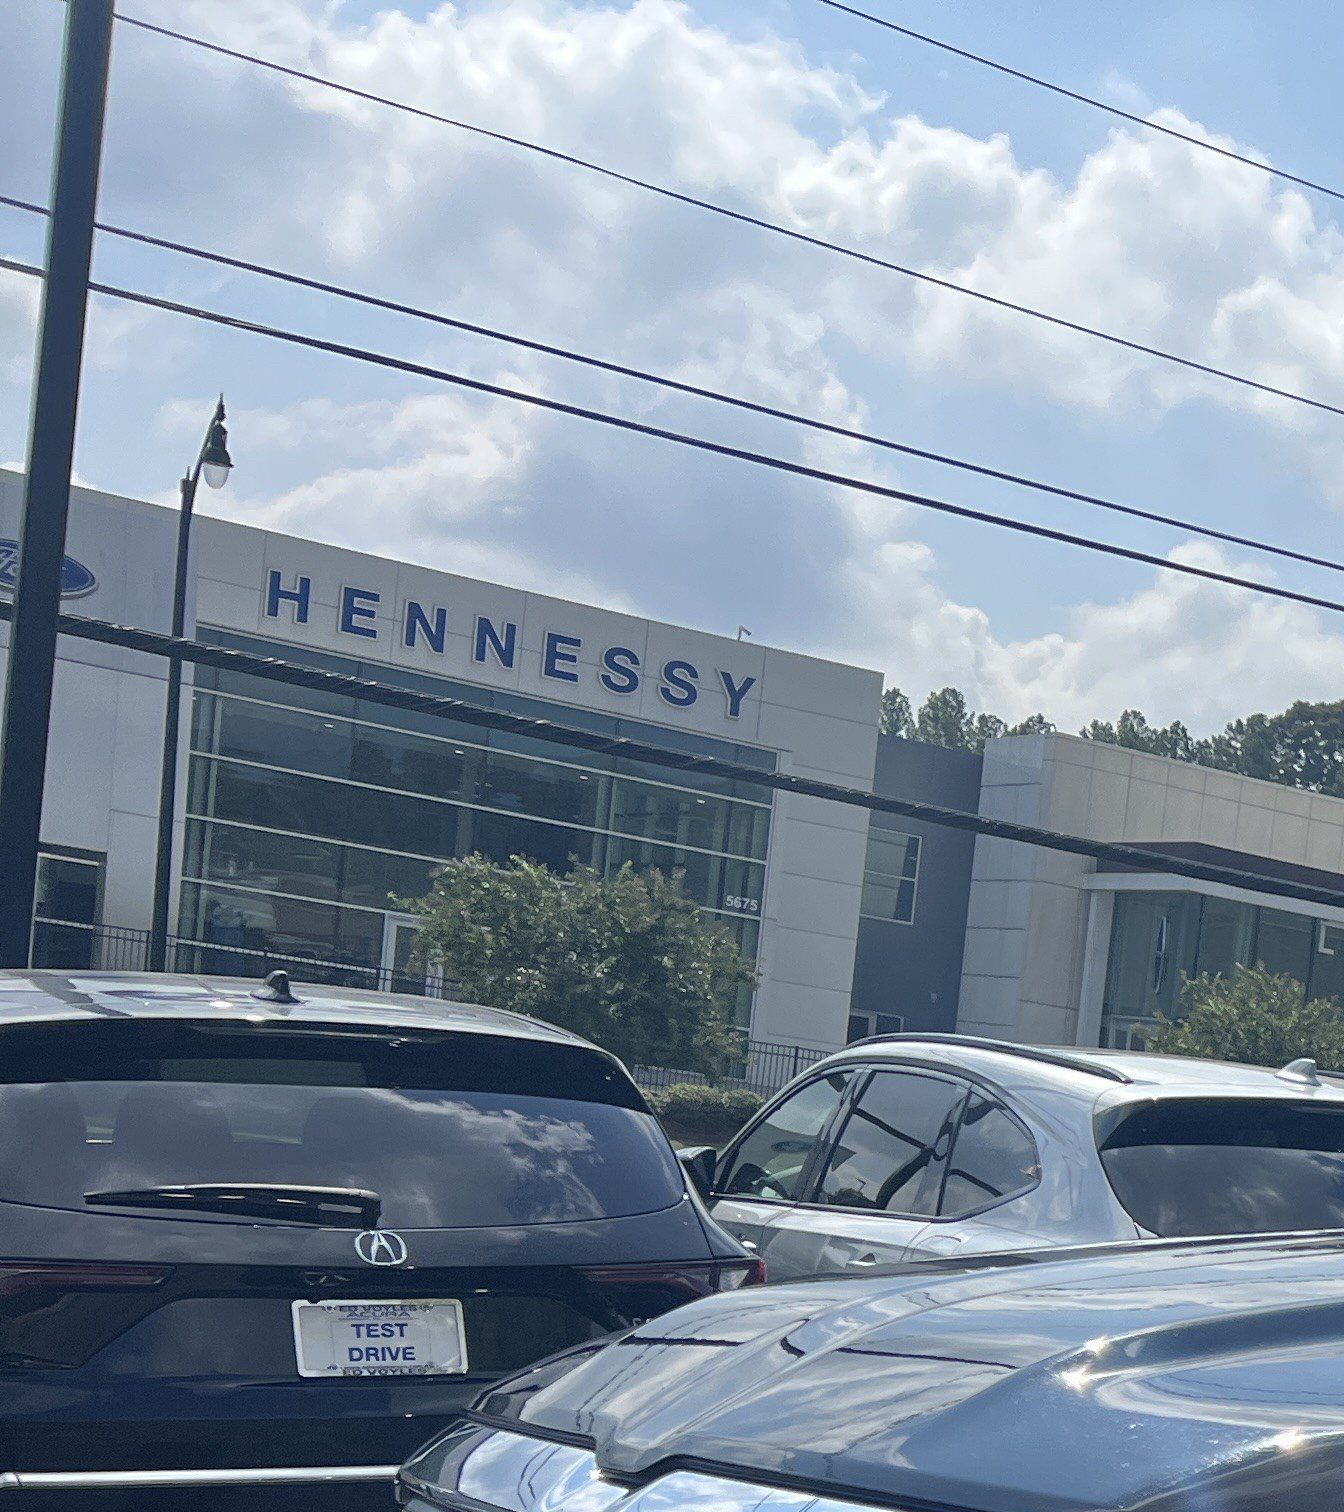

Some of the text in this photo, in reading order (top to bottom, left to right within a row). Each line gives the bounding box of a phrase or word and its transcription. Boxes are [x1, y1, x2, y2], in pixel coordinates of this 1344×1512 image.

[266, 568, 757, 721] HENNESSY
[725, 894, 758, 911] 5675
[351, 1322, 409, 1339] TEST
[348, 1346, 416, 1362] DRIVE
